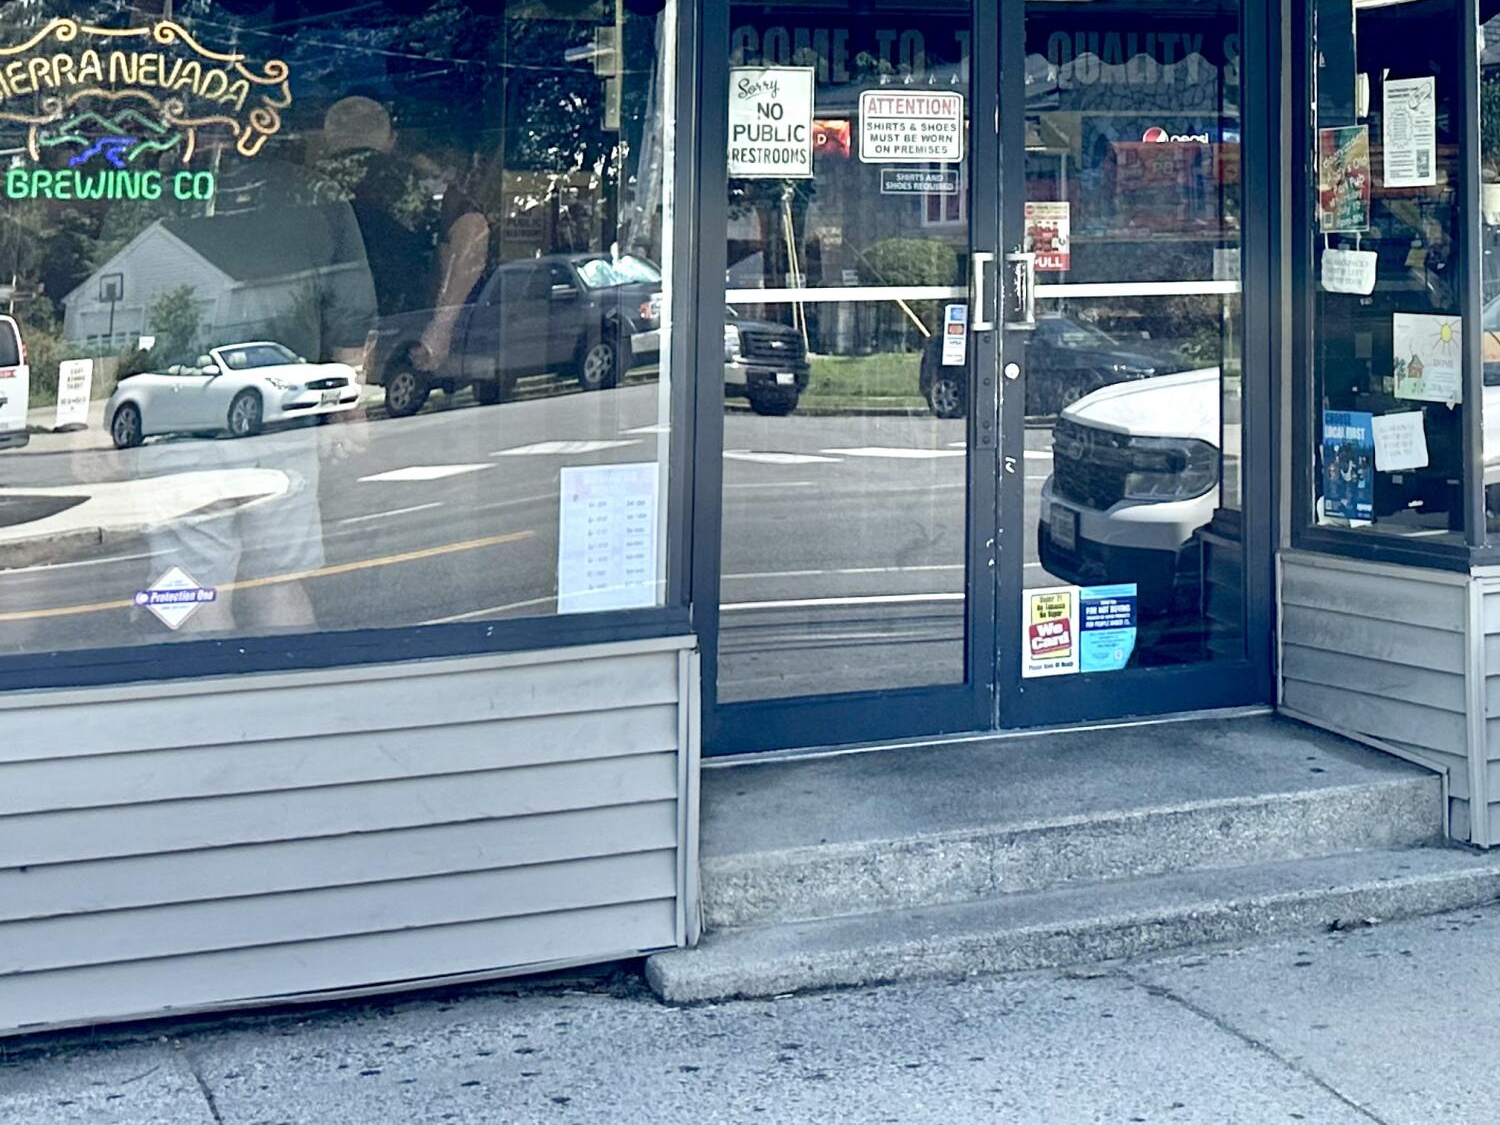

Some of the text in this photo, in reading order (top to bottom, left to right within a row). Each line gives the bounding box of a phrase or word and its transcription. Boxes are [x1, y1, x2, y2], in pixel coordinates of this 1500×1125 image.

[0, 49, 251, 112] IERRA NEVADA
[738, 77, 779, 101] Sorry
[757, 102, 784, 121] NO
[867, 97, 957, 116] ATTENTION!
[733, 123, 806, 143] PUBLIC
[866, 122, 907, 132] SHIRTS
[920, 122, 957, 133] SHOES
[869, 133, 954, 143] MUST BE WORN
[731, 147, 808, 165] RESTROOMS
[875, 145, 949, 155] ON PREMISES
[173, 170, 216, 200] CO
[1034, 257, 1064, 269] ULL
[1035, 621, 1064, 638] We
[1031, 631, 1071, 651] Card
